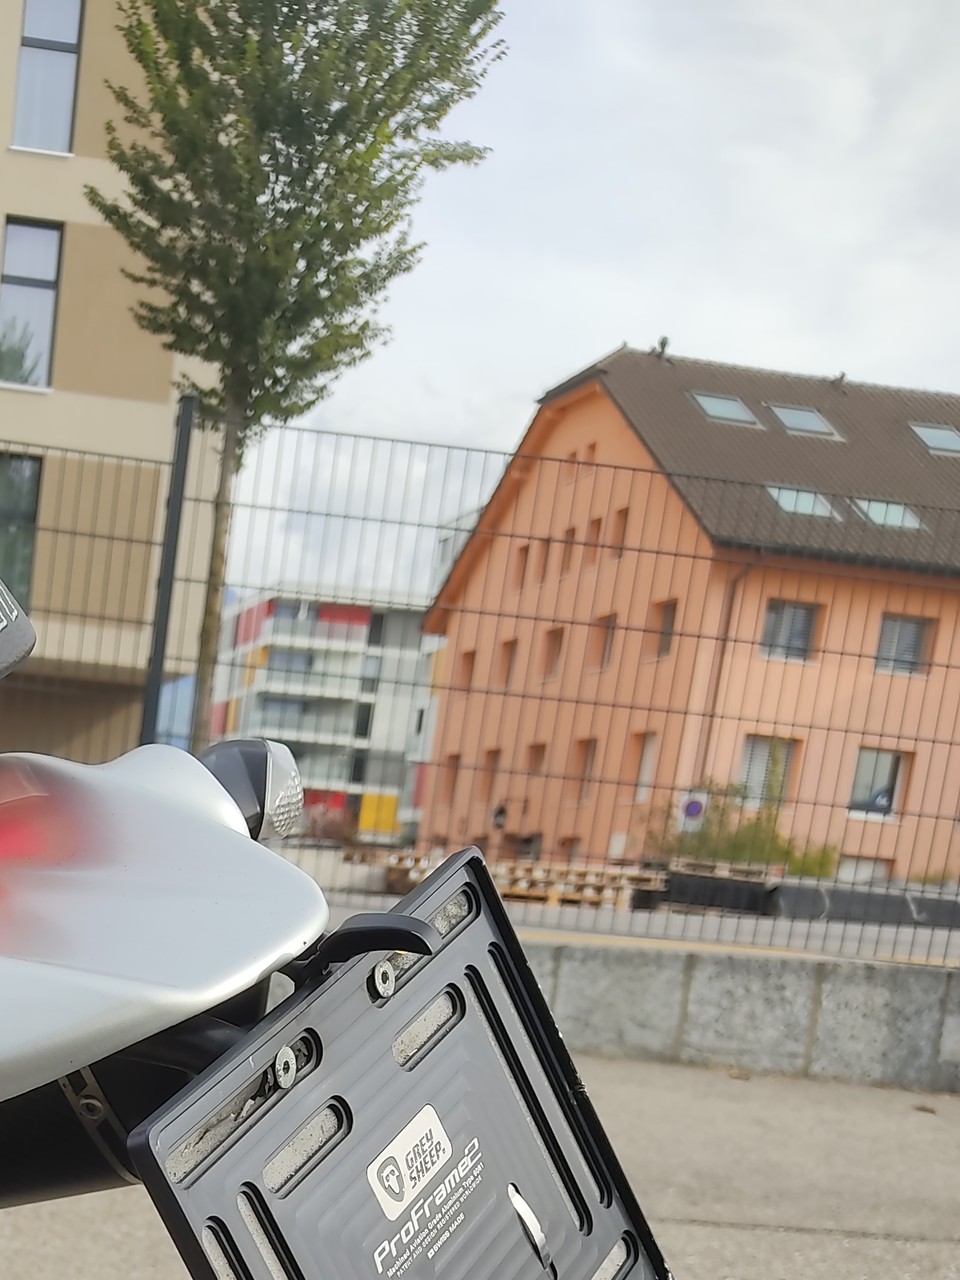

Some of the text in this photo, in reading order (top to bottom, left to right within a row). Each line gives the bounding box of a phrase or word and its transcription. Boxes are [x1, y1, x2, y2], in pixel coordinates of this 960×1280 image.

[405, 1128, 434, 1171] GREY
[373, 1137, 482, 1274] ProFrame2
[386, 1249, 411, 1278] Machined
[409, 1228, 429, 1252] Aviation
[427, 1212, 442, 1230] Grade
[462, 1174, 475, 1188] Type
[396, 1176, 482, 1277] PATENT AND DESIGN REGISTERED WORLDWIDE
[433, 1212, 465, 1252] SWISS MADE
